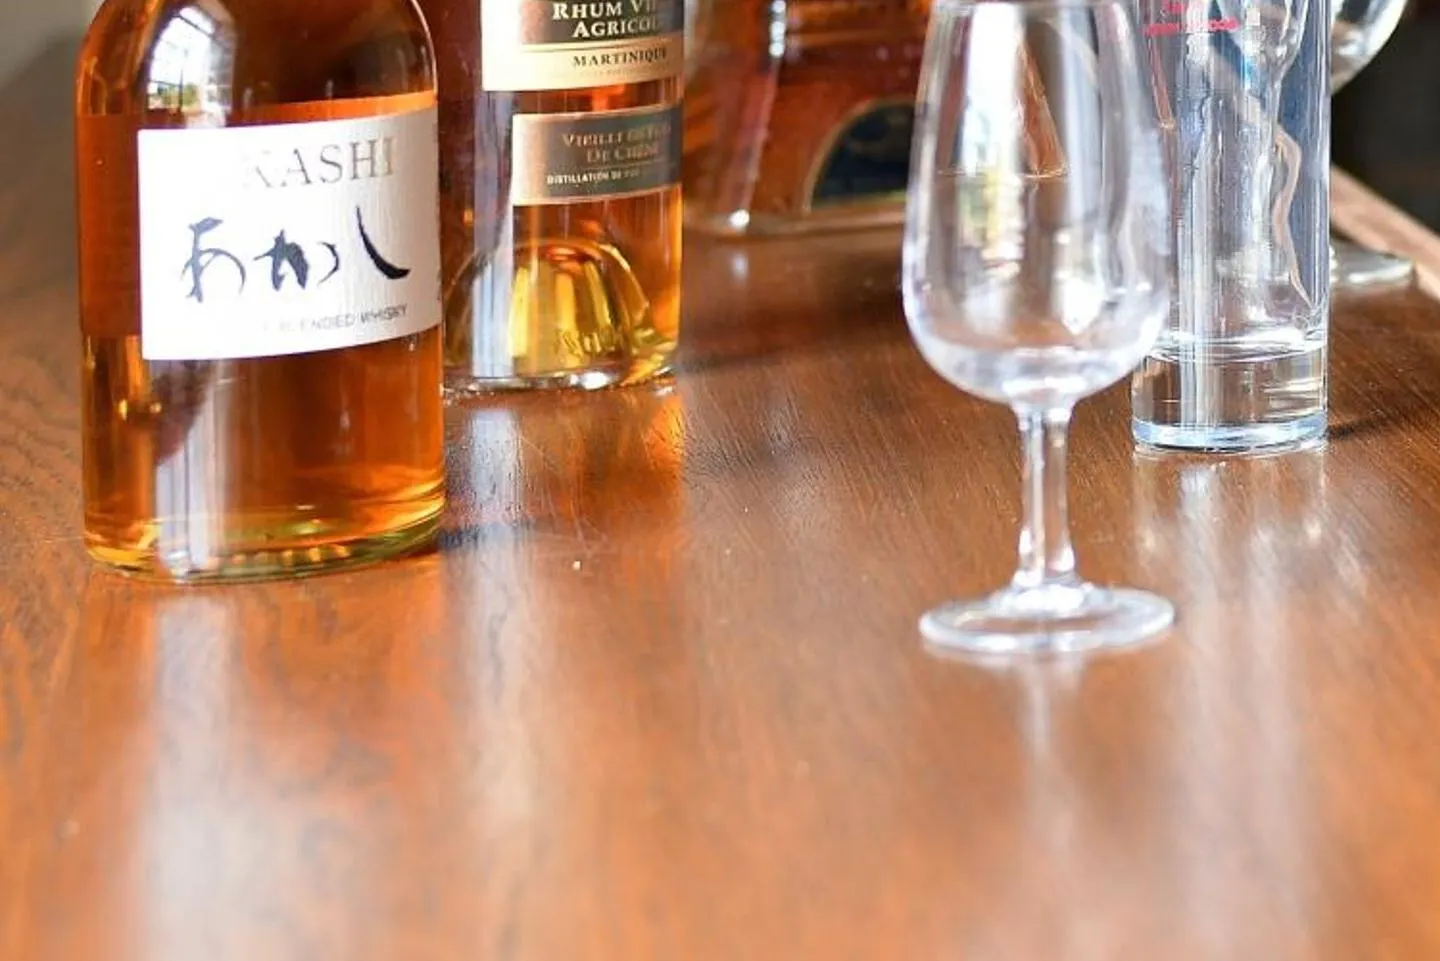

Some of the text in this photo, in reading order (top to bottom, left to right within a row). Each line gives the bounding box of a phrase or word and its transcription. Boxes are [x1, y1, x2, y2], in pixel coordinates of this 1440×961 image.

[552, 0, 623, 20] RHUM
[180, 204, 411, 304] あかし
